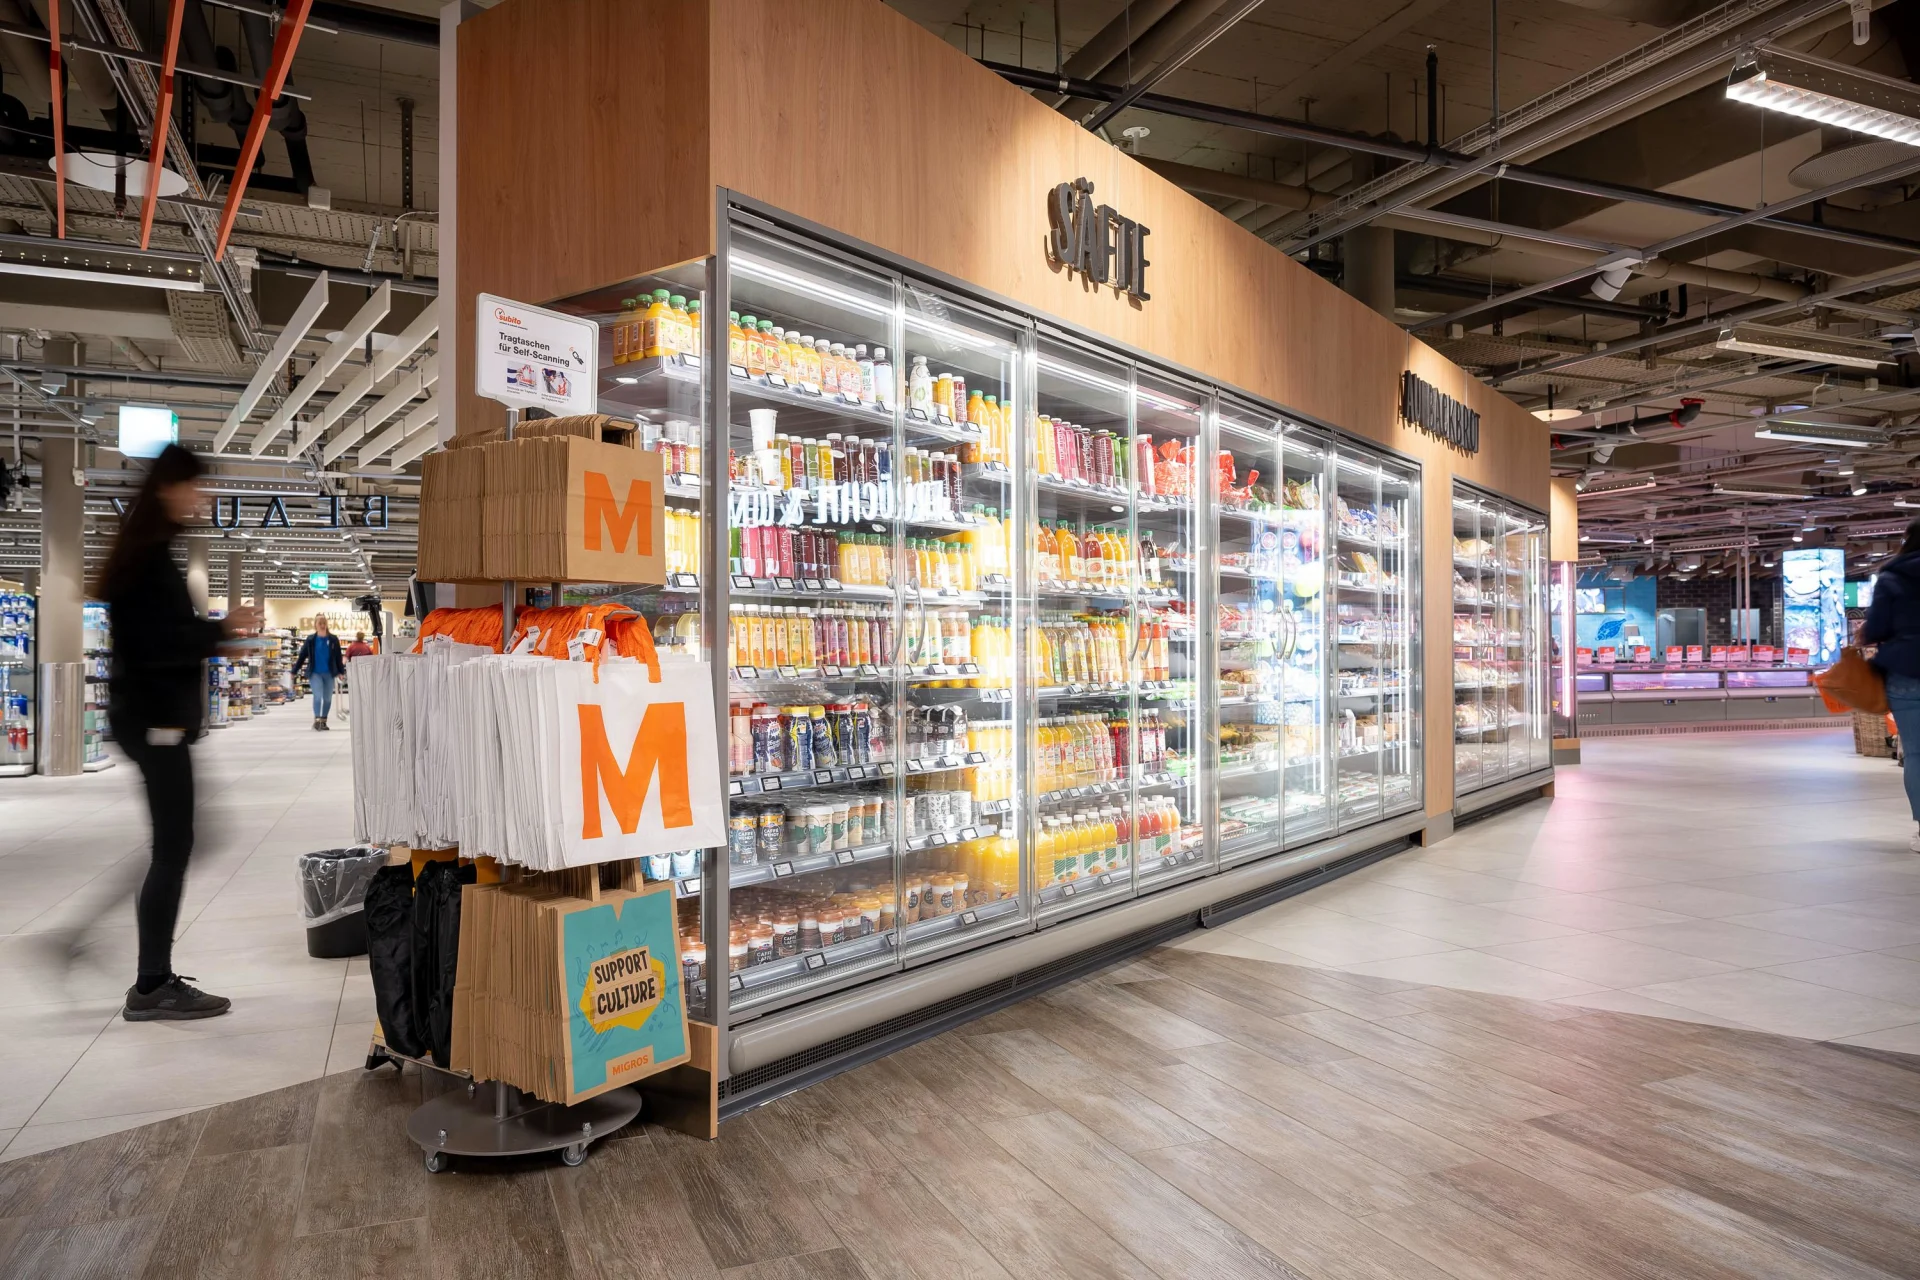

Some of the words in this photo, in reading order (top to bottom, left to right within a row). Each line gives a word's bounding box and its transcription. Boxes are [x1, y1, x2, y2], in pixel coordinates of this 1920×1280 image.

[1049, 176, 1151, 302] SÄFTE
[499, 315, 521, 325] subito
[499, 331, 550, 351] Tragtaschen
[499, 342, 512, 353] für
[514, 346, 570, 367] Self-Scanning
[583, 470, 652, 557] M
[577, 701, 694, 840] M
[594, 950, 649, 985] SUPPORT
[597, 977, 656, 1016] CULTURE
[612, 1054, 649, 1076] MIGROS
